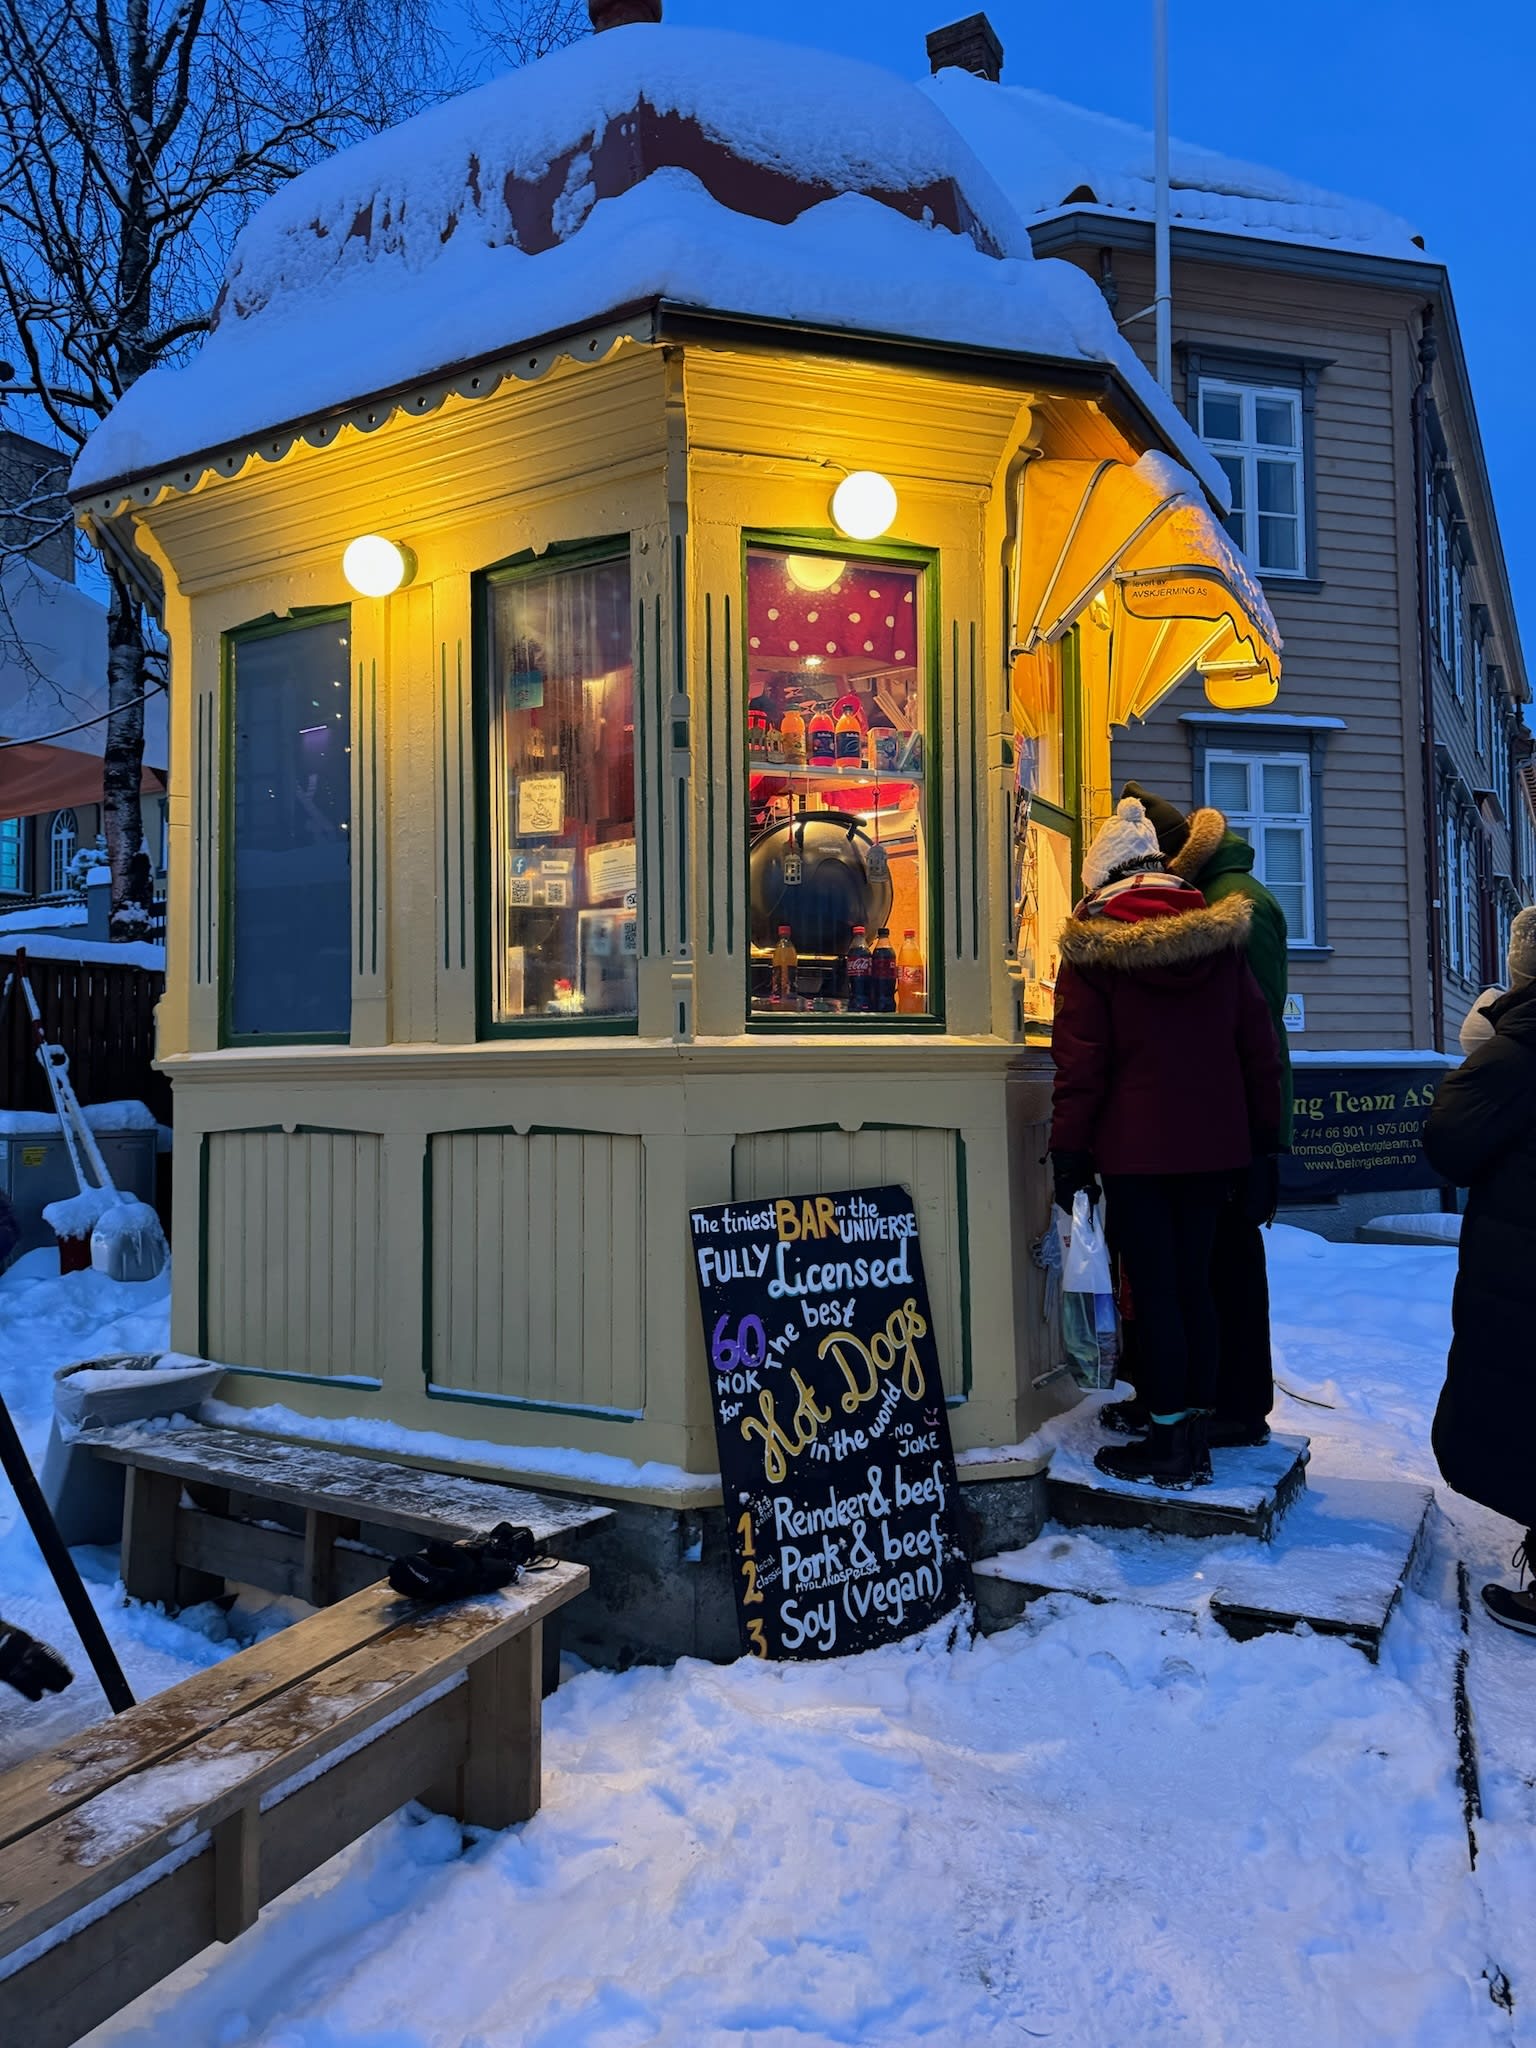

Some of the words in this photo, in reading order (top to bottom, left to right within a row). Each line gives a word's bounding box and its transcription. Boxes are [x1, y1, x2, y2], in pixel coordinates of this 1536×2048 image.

[1132, 587, 1195, 599] AVSKJERMING
[1196, 587, 1208, 597] AS
[1293, 1098, 1325, 1120] ng
[1330, 1090, 1396, 1114] Team
[1403, 1083, 1435, 1108] AS
[1326, 1126, 1340, 1139] 66
[1343, 1125, 1365, 1138] 901
[1377, 1122, 1397, 1136] 975
[1399, 1120, 1419, 1134] 000
[1304, 1154, 1416, 1171] www.betongteam.no
[692, 1213, 720, 1234] The
[724, 1204, 777, 1233] tiniest
[775, 1197, 840, 1241] BAR
[835, 1201, 846, 1217] in
[848, 1197, 879, 1218] the
[839, 1212, 918, 1243] UNIVERSE
[698, 1243, 770, 1287] FULLY
[767, 1237, 914, 1300] Licensed
[801, 1298, 856, 1328] best
[712, 1313, 766, 1371] 60
[717, 1369, 762, 1395] NOK
[741, 1368, 831, 1484] Hot
[818, 1298, 927, 1413] Dogs
[719, 1400, 744, 1424] for
[810, 1439, 830, 1463] in
[831, 1427, 869, 1461] the
[869, 1377, 902, 1438] world
[774, 1485, 869, 1541] Reindeer
[866, 1465, 892, 1517] &
[895, 1460, 945, 1512] beef
[737, 1511, 756, 1557] 1
[780, 1535, 842, 1590] Pork
[850, 1519, 876, 1569] &
[881, 1514, 944, 1566] beef
[741, 1560, 764, 1605] 2
[780, 1599, 837, 1651] Soy
